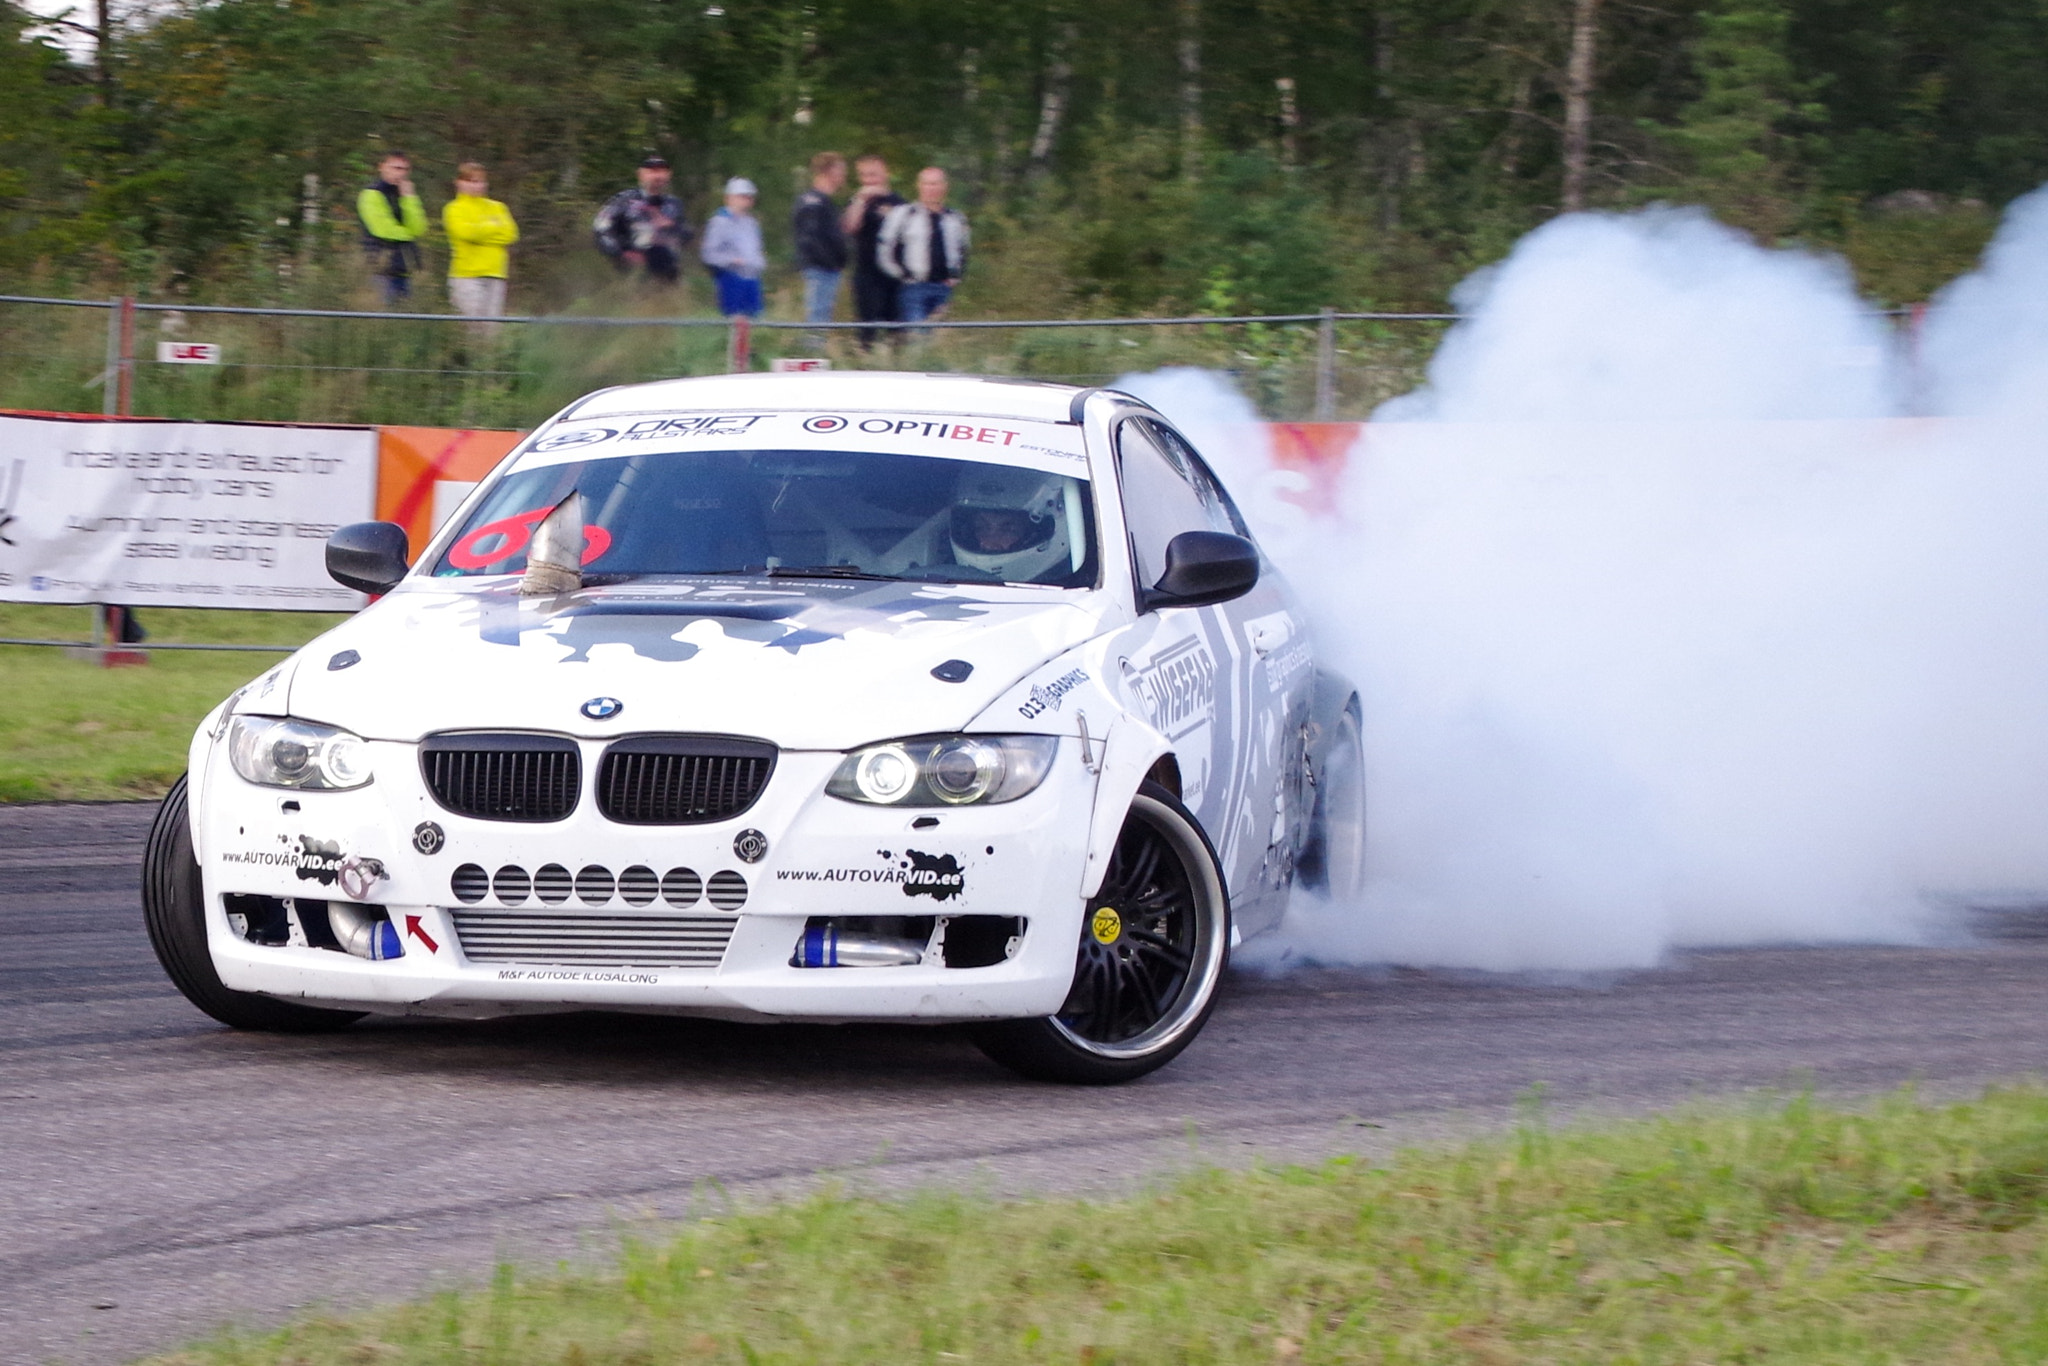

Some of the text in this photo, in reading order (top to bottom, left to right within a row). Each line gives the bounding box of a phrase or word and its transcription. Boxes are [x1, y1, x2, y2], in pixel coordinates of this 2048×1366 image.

[627, 415, 777, 434] DRIFT
[859, 418, 1020, 446] OPTIBET
[1018, 697, 1046, 720] 013
[776, 866, 962, 886] www.AUTOVÄRVID.ee
